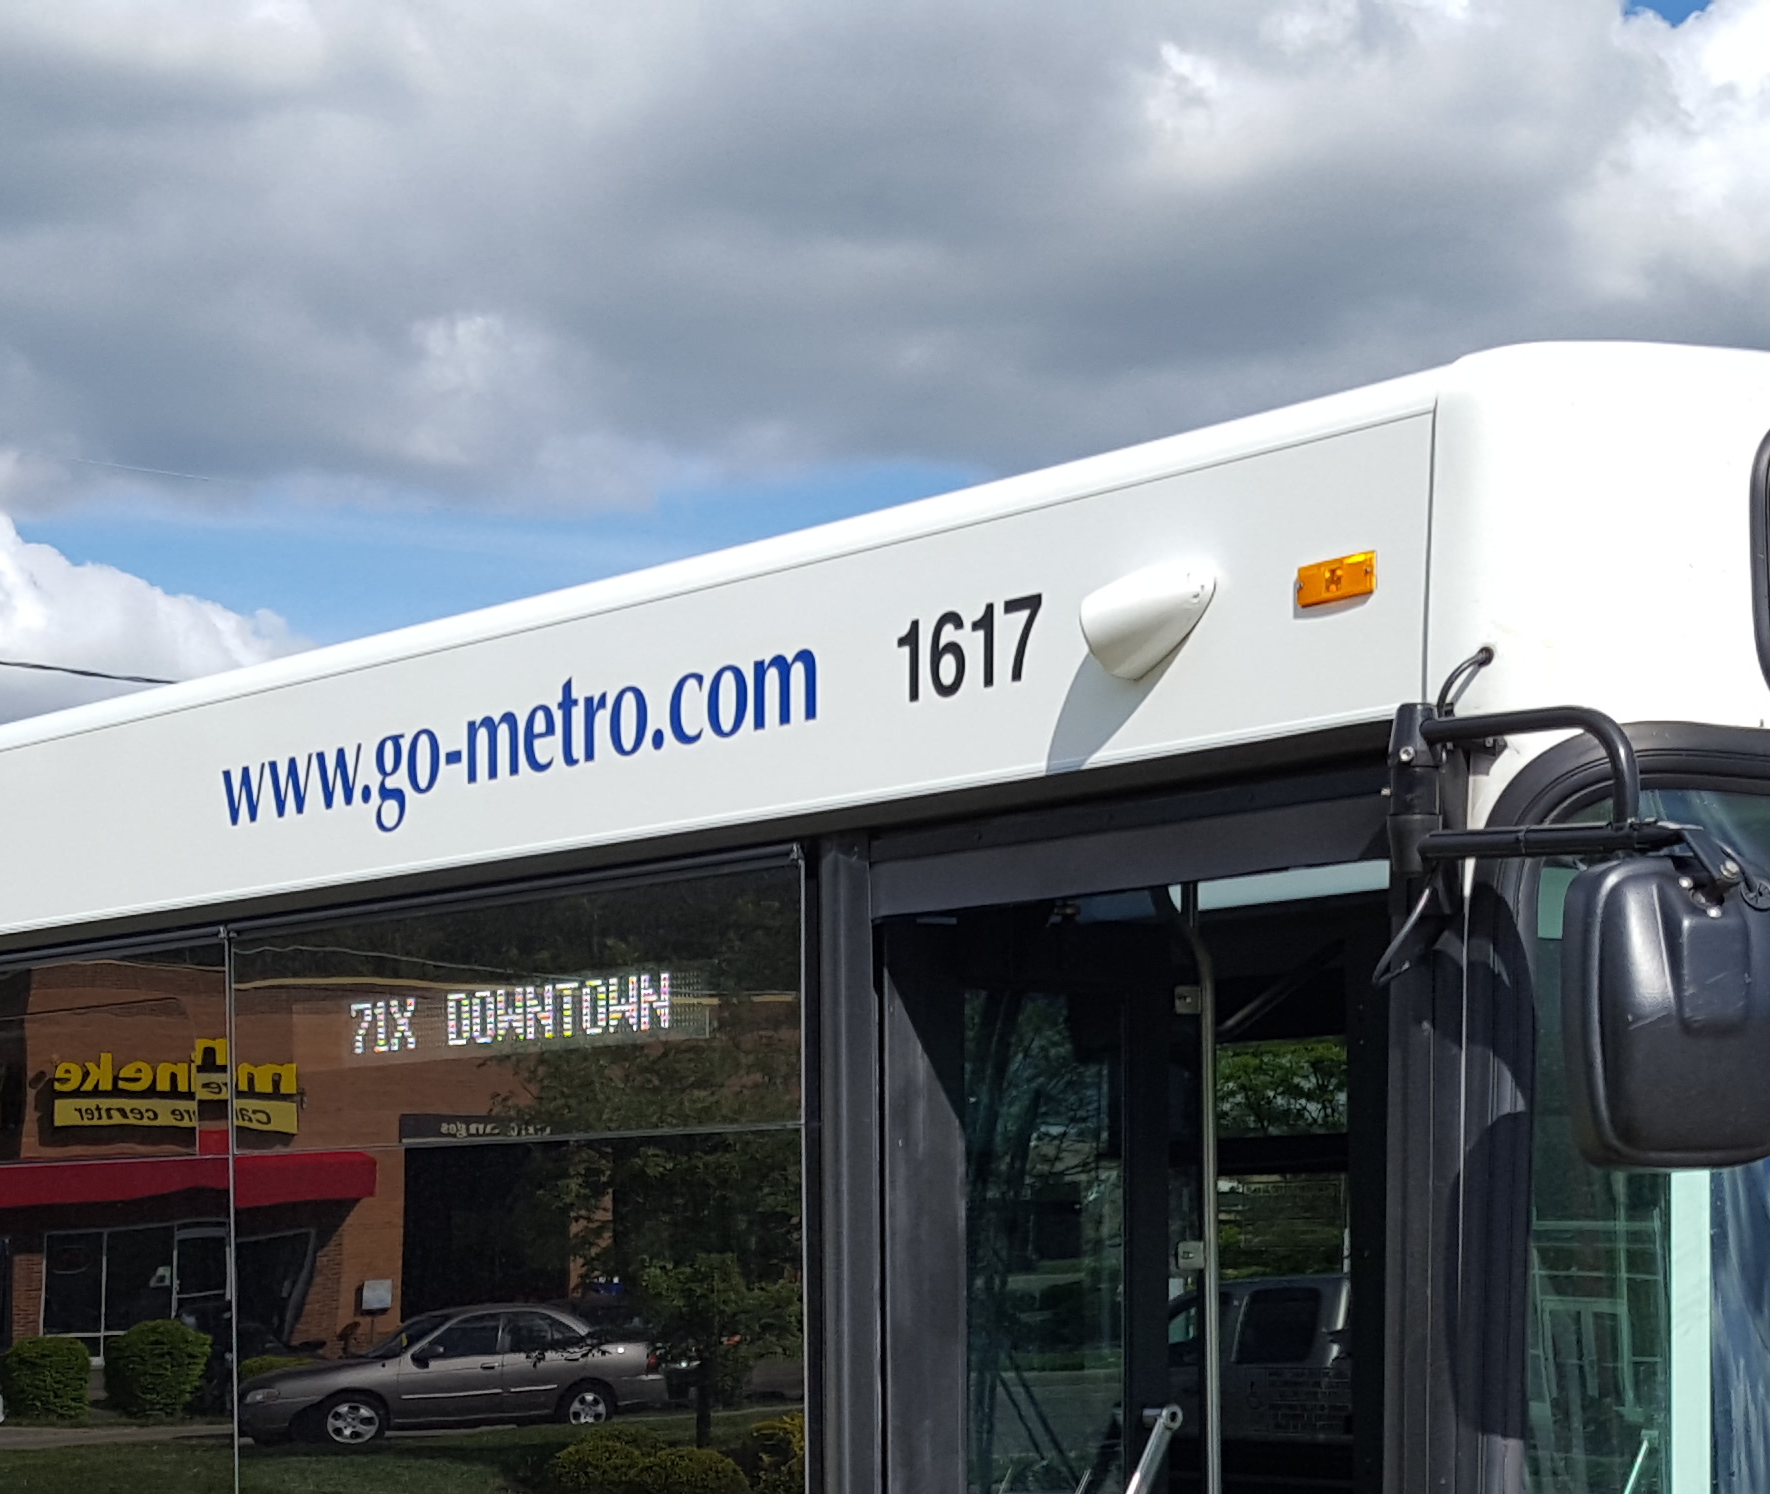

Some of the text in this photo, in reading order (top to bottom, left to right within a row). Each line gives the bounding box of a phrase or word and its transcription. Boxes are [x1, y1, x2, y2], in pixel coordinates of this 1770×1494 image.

[896, 593, 1043, 704] 1617
[221, 647, 819, 833] www.go-metro.com
[350, 972, 672, 1055] 71X DOWNTOWN
